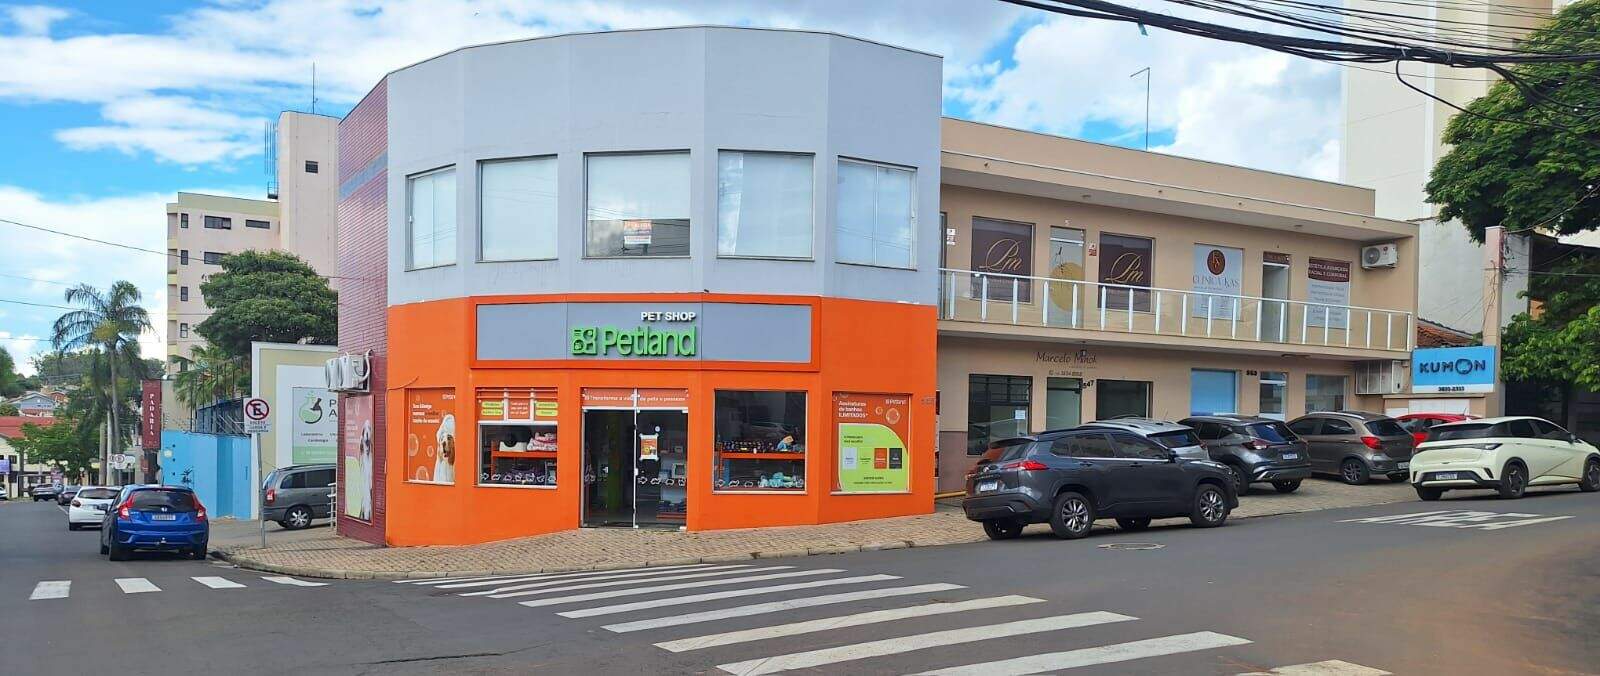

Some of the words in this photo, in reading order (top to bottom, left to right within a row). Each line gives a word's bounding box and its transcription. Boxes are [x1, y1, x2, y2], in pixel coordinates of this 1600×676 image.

[640, 311, 662, 321] PET
[664, 311, 697, 322] SHOP
[603, 326, 697, 356] Petland
[1419, 358, 1486, 375] KUMON
